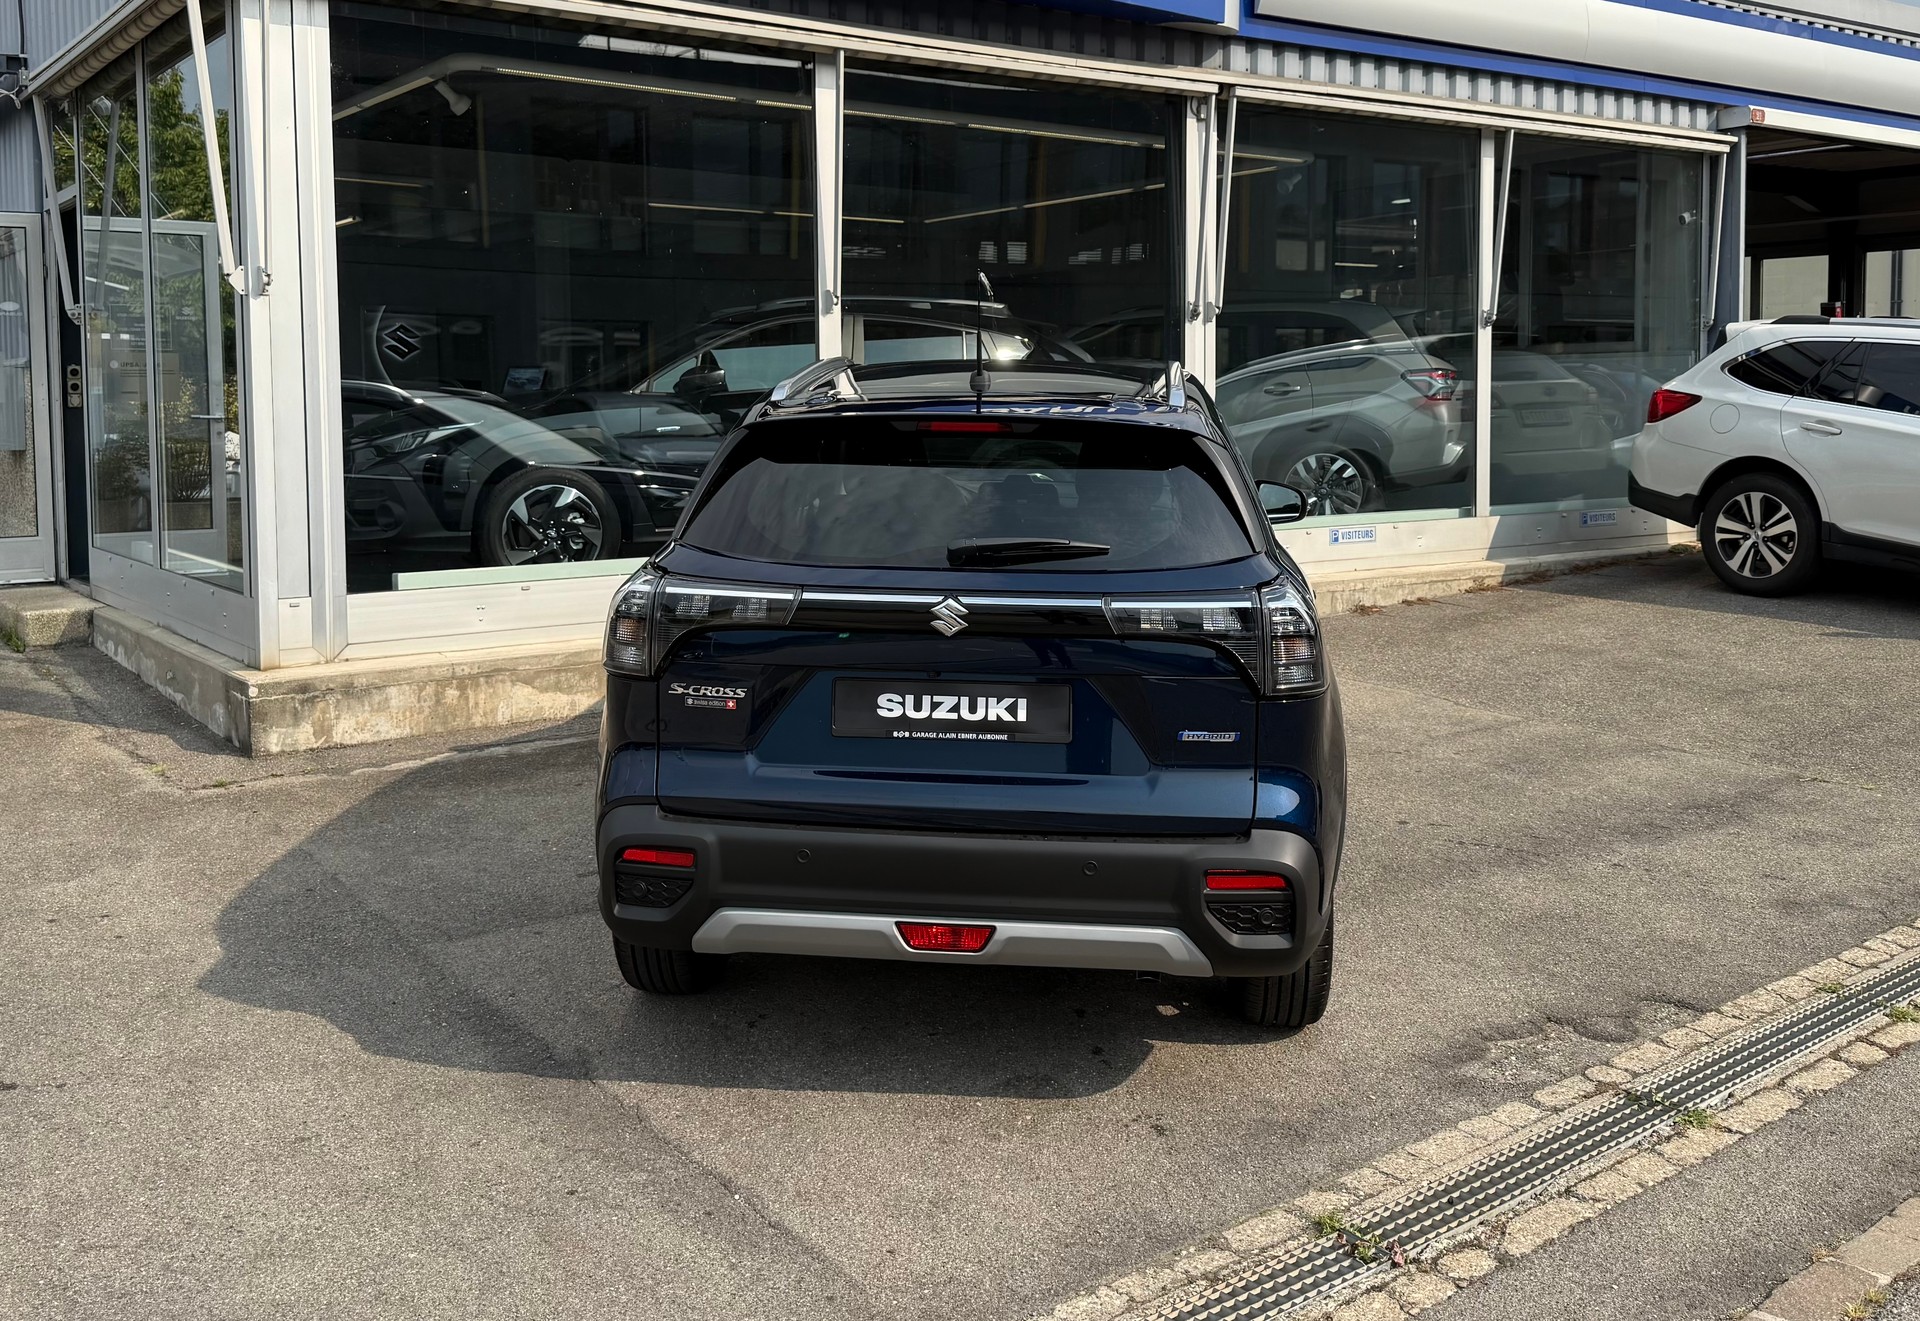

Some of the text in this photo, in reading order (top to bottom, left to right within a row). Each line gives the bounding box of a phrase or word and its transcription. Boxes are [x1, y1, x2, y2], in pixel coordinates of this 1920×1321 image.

[1590, 512, 1616, 522] VISITEURS
[1341, 530, 1374, 540] VISITEURS
[668, 682, 748, 698] S-CROSS
[876, 693, 1027, 722] SUZUKI
